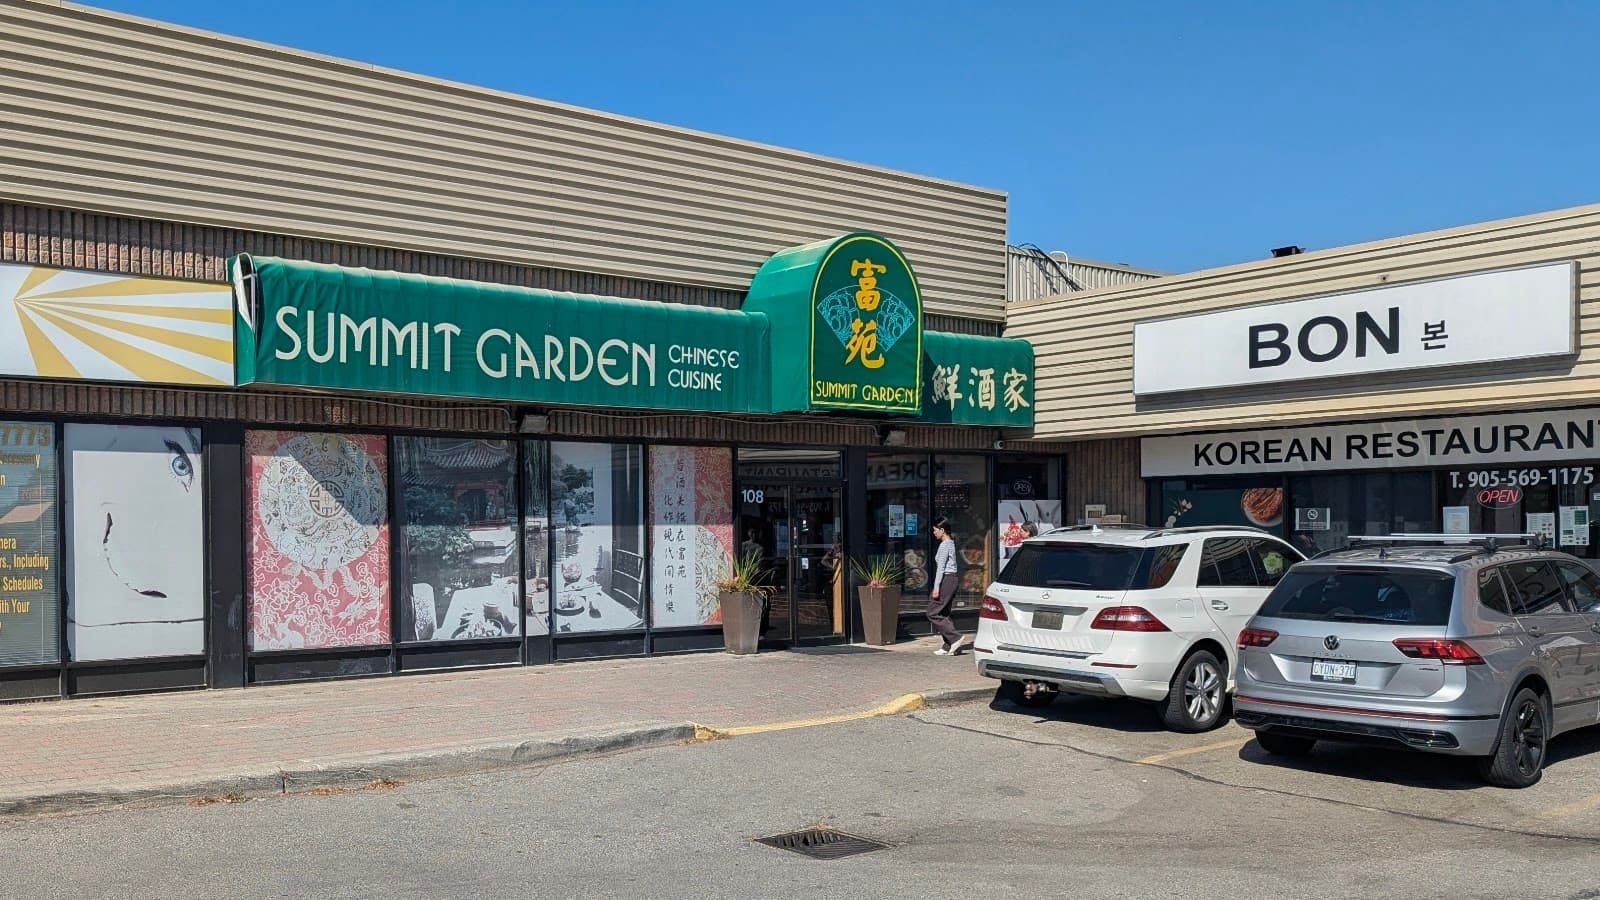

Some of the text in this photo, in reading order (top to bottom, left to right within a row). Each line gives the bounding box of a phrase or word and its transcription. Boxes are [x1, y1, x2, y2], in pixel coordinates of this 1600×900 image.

[845, 258, 887, 369] 富苑
[275, 305, 656, 387] SUMMIT GARDEN
[1249, 306, 1449, 369] BON 본
[667, 344, 740, 369] CHINESE
[667, 368, 722, 392] CUISINE
[816, 380, 914, 403] SUMMIT GARDEN
[929, 363, 1031, 412] 鮮酒家
[1194, 419, 1600, 467] KOREAN RESTAURAN
[1450, 466, 1595, 488] T. 905-569-1175
[741, 489, 764, 504] 108
[1479, 489, 1519, 504] OPEN
[13, 553, 49, 571] Including
[3, 575, 44, 591] Schedules
[12, 598, 30, 613] Your
